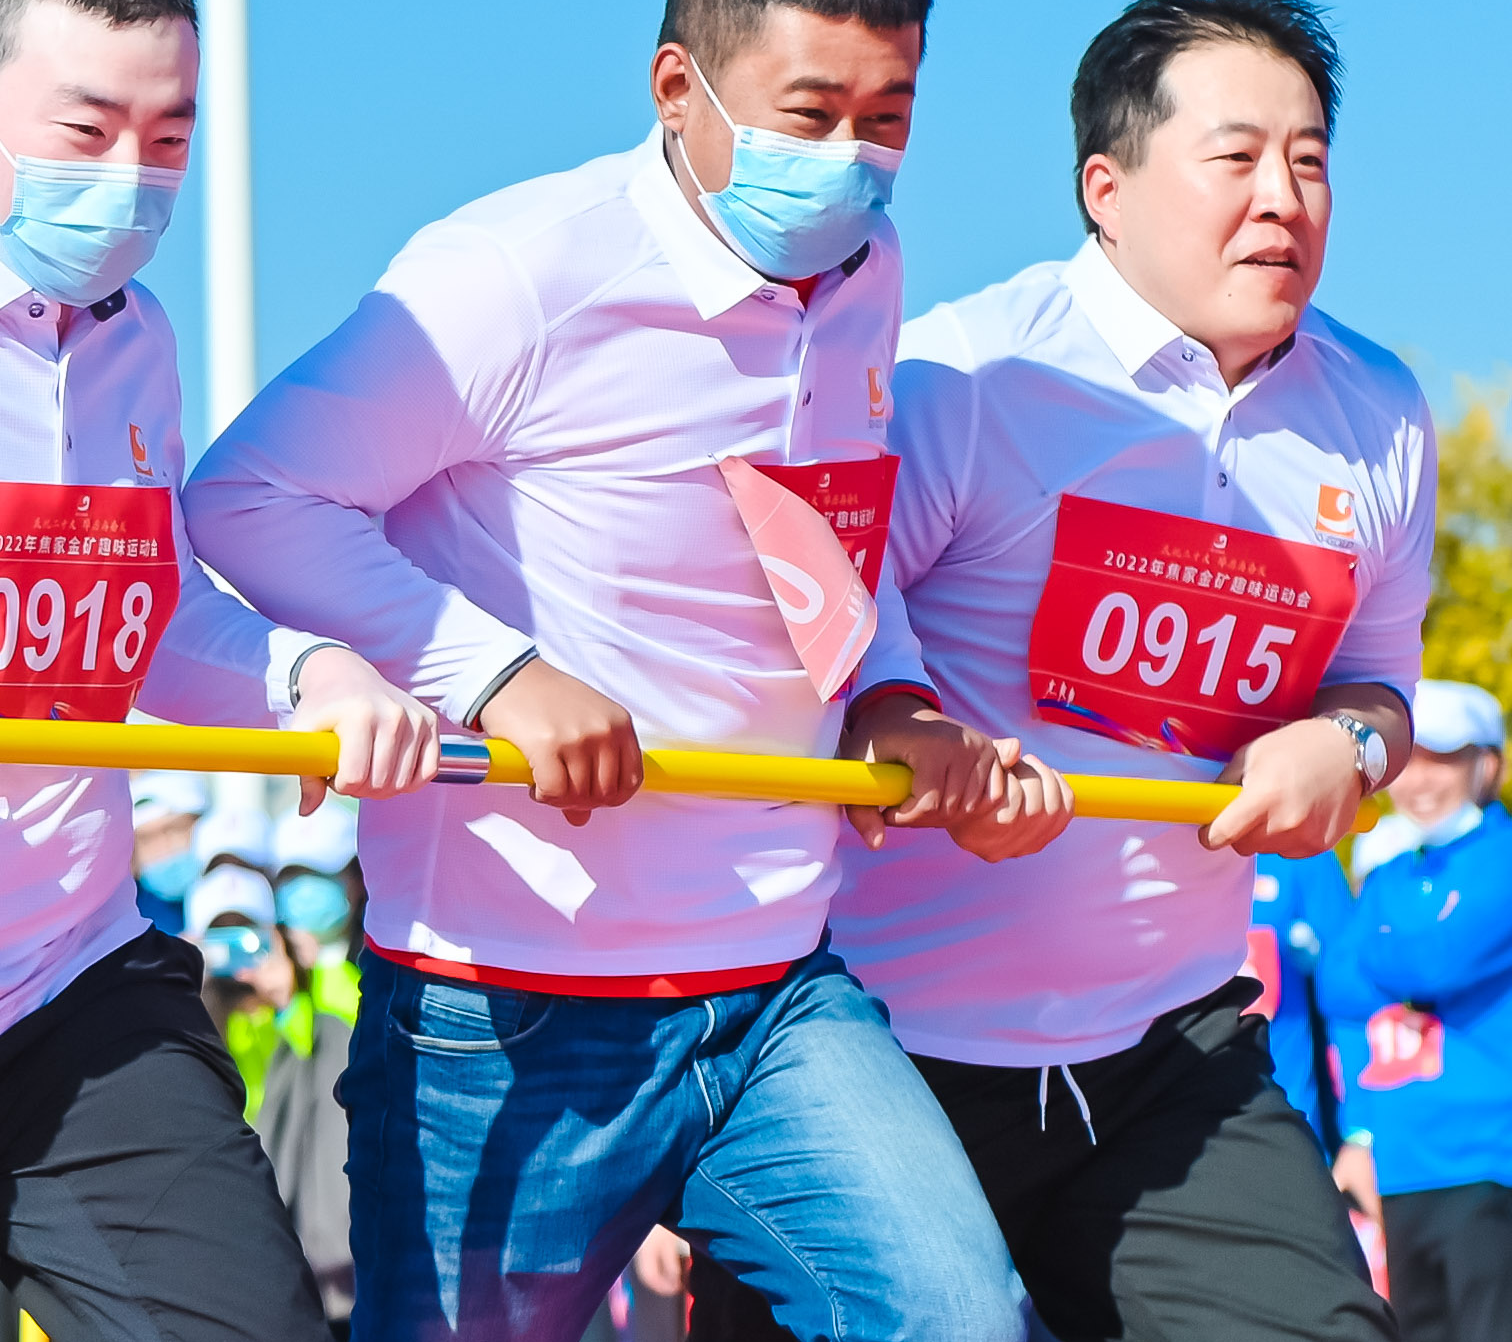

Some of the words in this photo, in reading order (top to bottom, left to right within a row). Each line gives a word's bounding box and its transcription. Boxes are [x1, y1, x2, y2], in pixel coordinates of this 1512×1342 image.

[1103, 549, 1312, 610] 2022年焦家金矿趣味运动会
[1080, 591, 1297, 705] 0915
